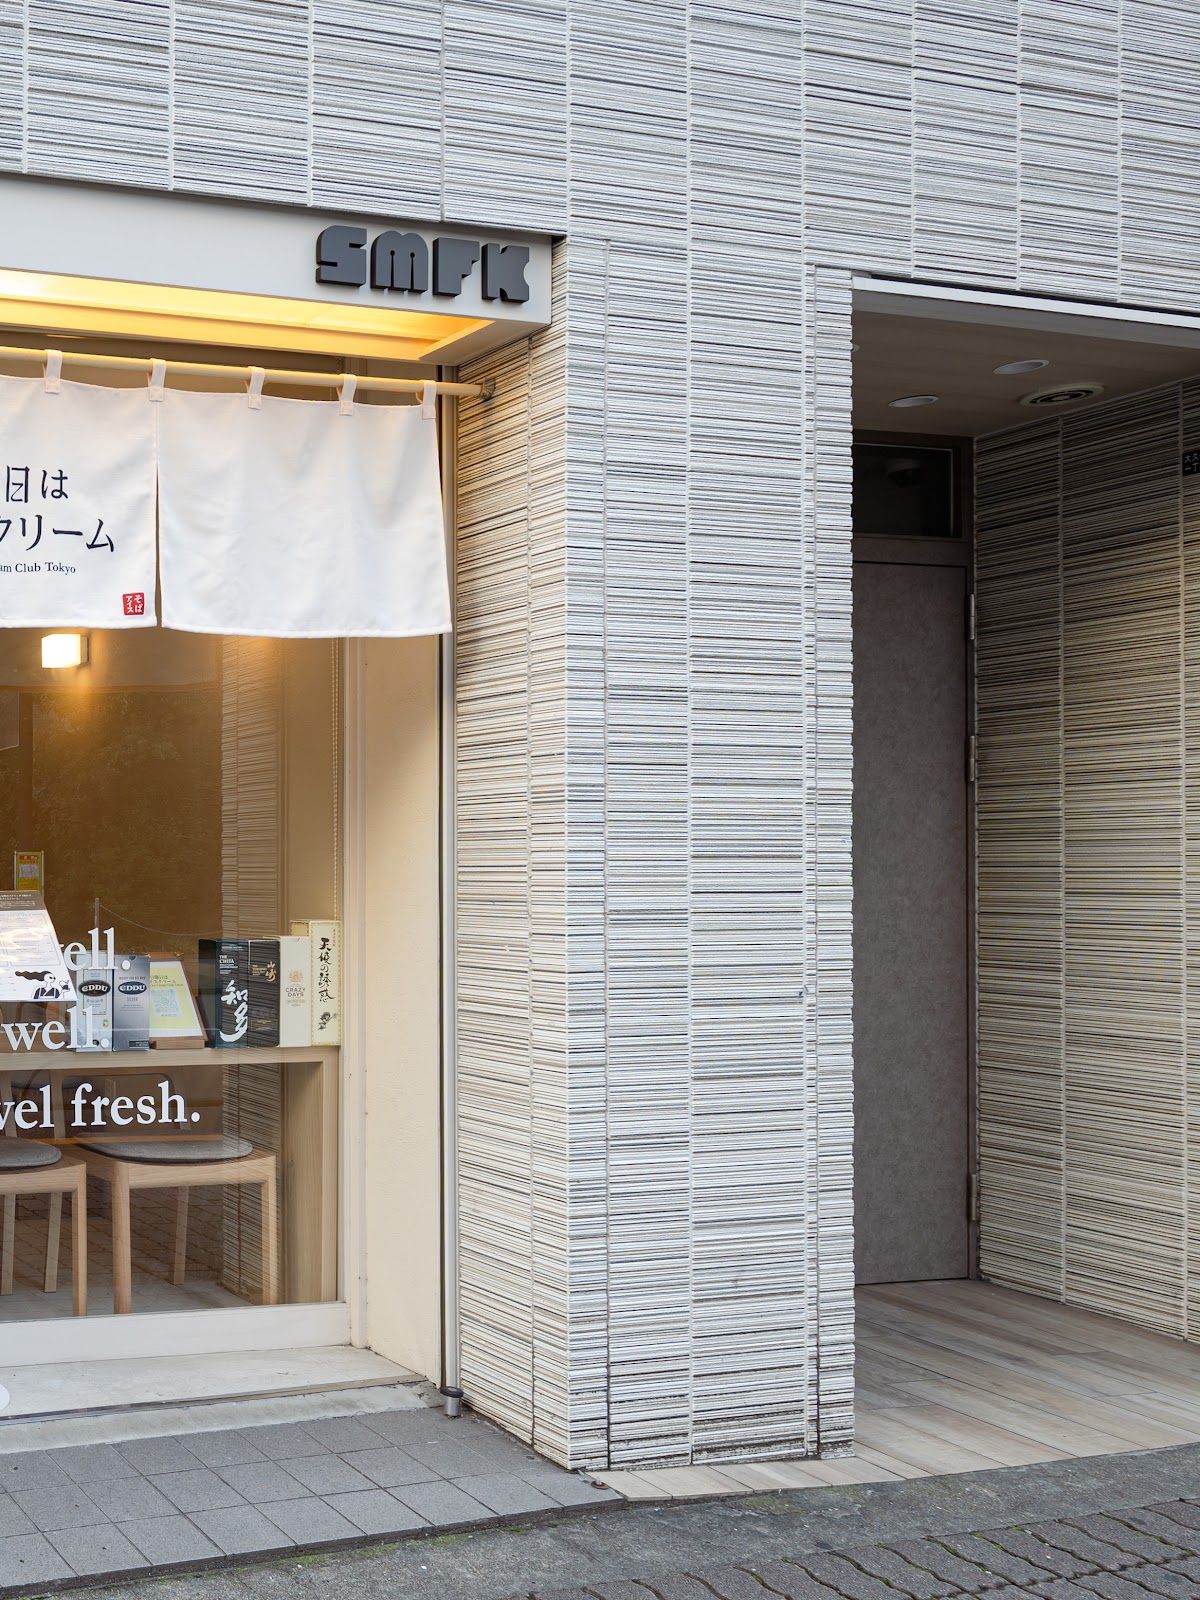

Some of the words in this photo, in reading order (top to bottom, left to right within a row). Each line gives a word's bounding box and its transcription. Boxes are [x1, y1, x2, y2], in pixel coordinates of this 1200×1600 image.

[316, 225, 530, 304] SMFK
[1184, 453, 1200, 464] 大久
[1184, 462, 1200, 472] 一丁
[15, 562, 41, 573] Club
[44, 562, 76, 575] Tokyo
[125, 595, 135, 614] アイス
[134, 594, 143, 613] そば
[59, 927, 131, 971] ell.
[219, 979, 248, 1043] 知多
[1, 1005, 110, 1050] well.
[71, 1080, 201, 1128] fresh.
